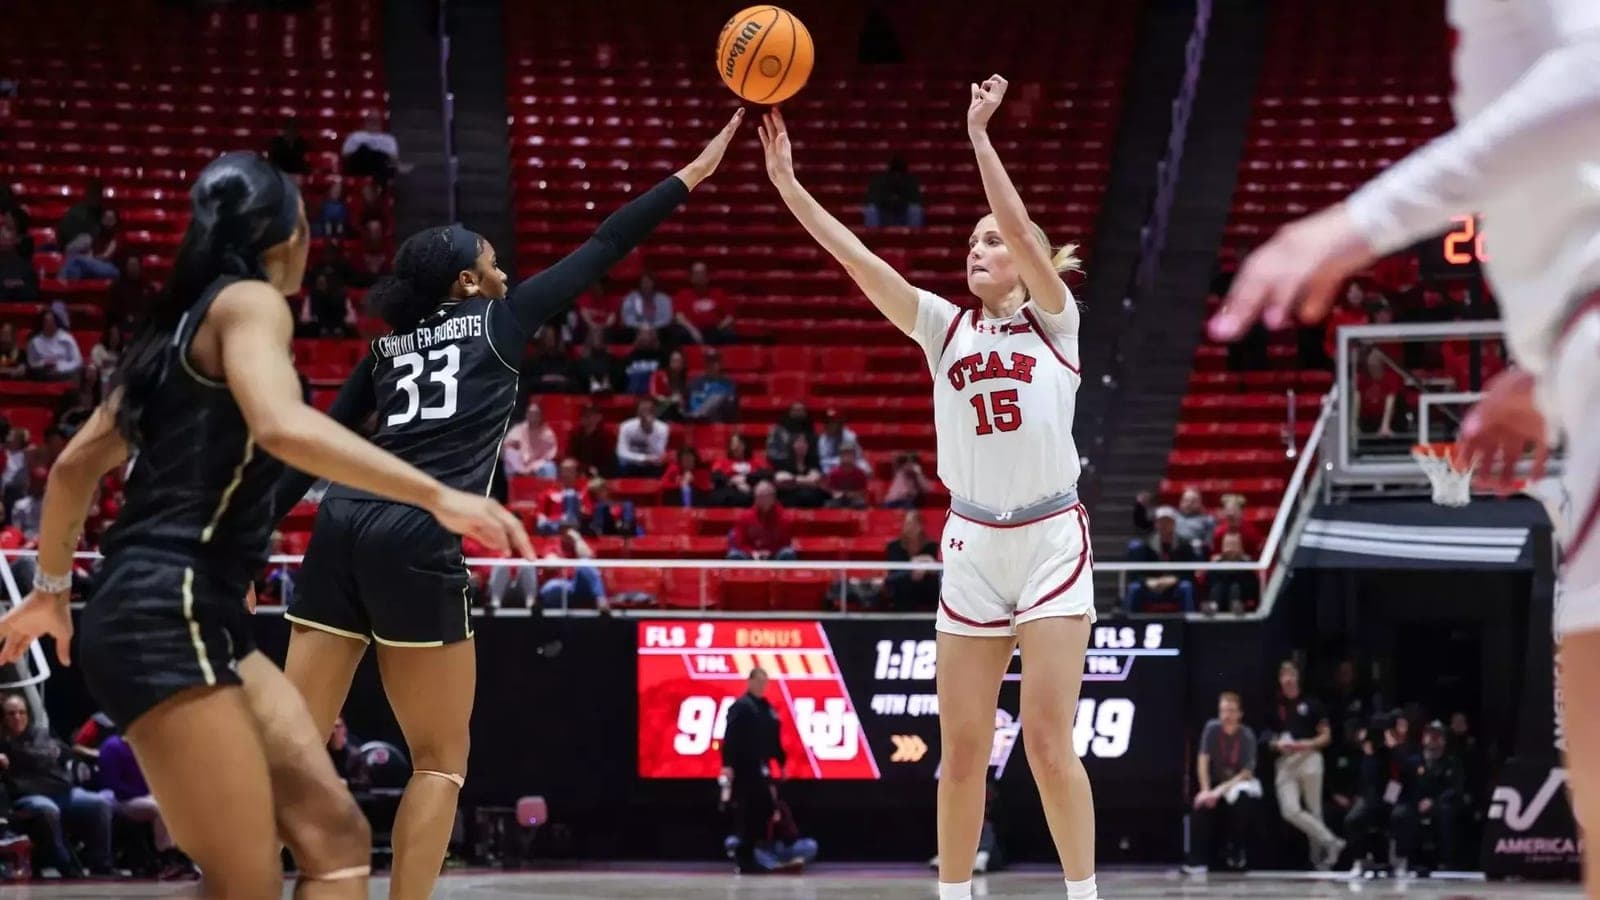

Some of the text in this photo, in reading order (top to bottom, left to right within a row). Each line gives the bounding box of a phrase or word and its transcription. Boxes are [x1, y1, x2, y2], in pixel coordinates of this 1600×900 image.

[725, 21, 762, 78] Wilson
[387, 344, 460, 427] 33
[947, 351, 1037, 391] UTAH
[969, 388, 1022, 435] 15
[645, 622, 802, 648] FLS 3 BONUS
[1094, 624, 1163, 649] FLS 5
[874, 640, 937, 679] 1:12
[1495, 838, 1575, 854] AMERICA
